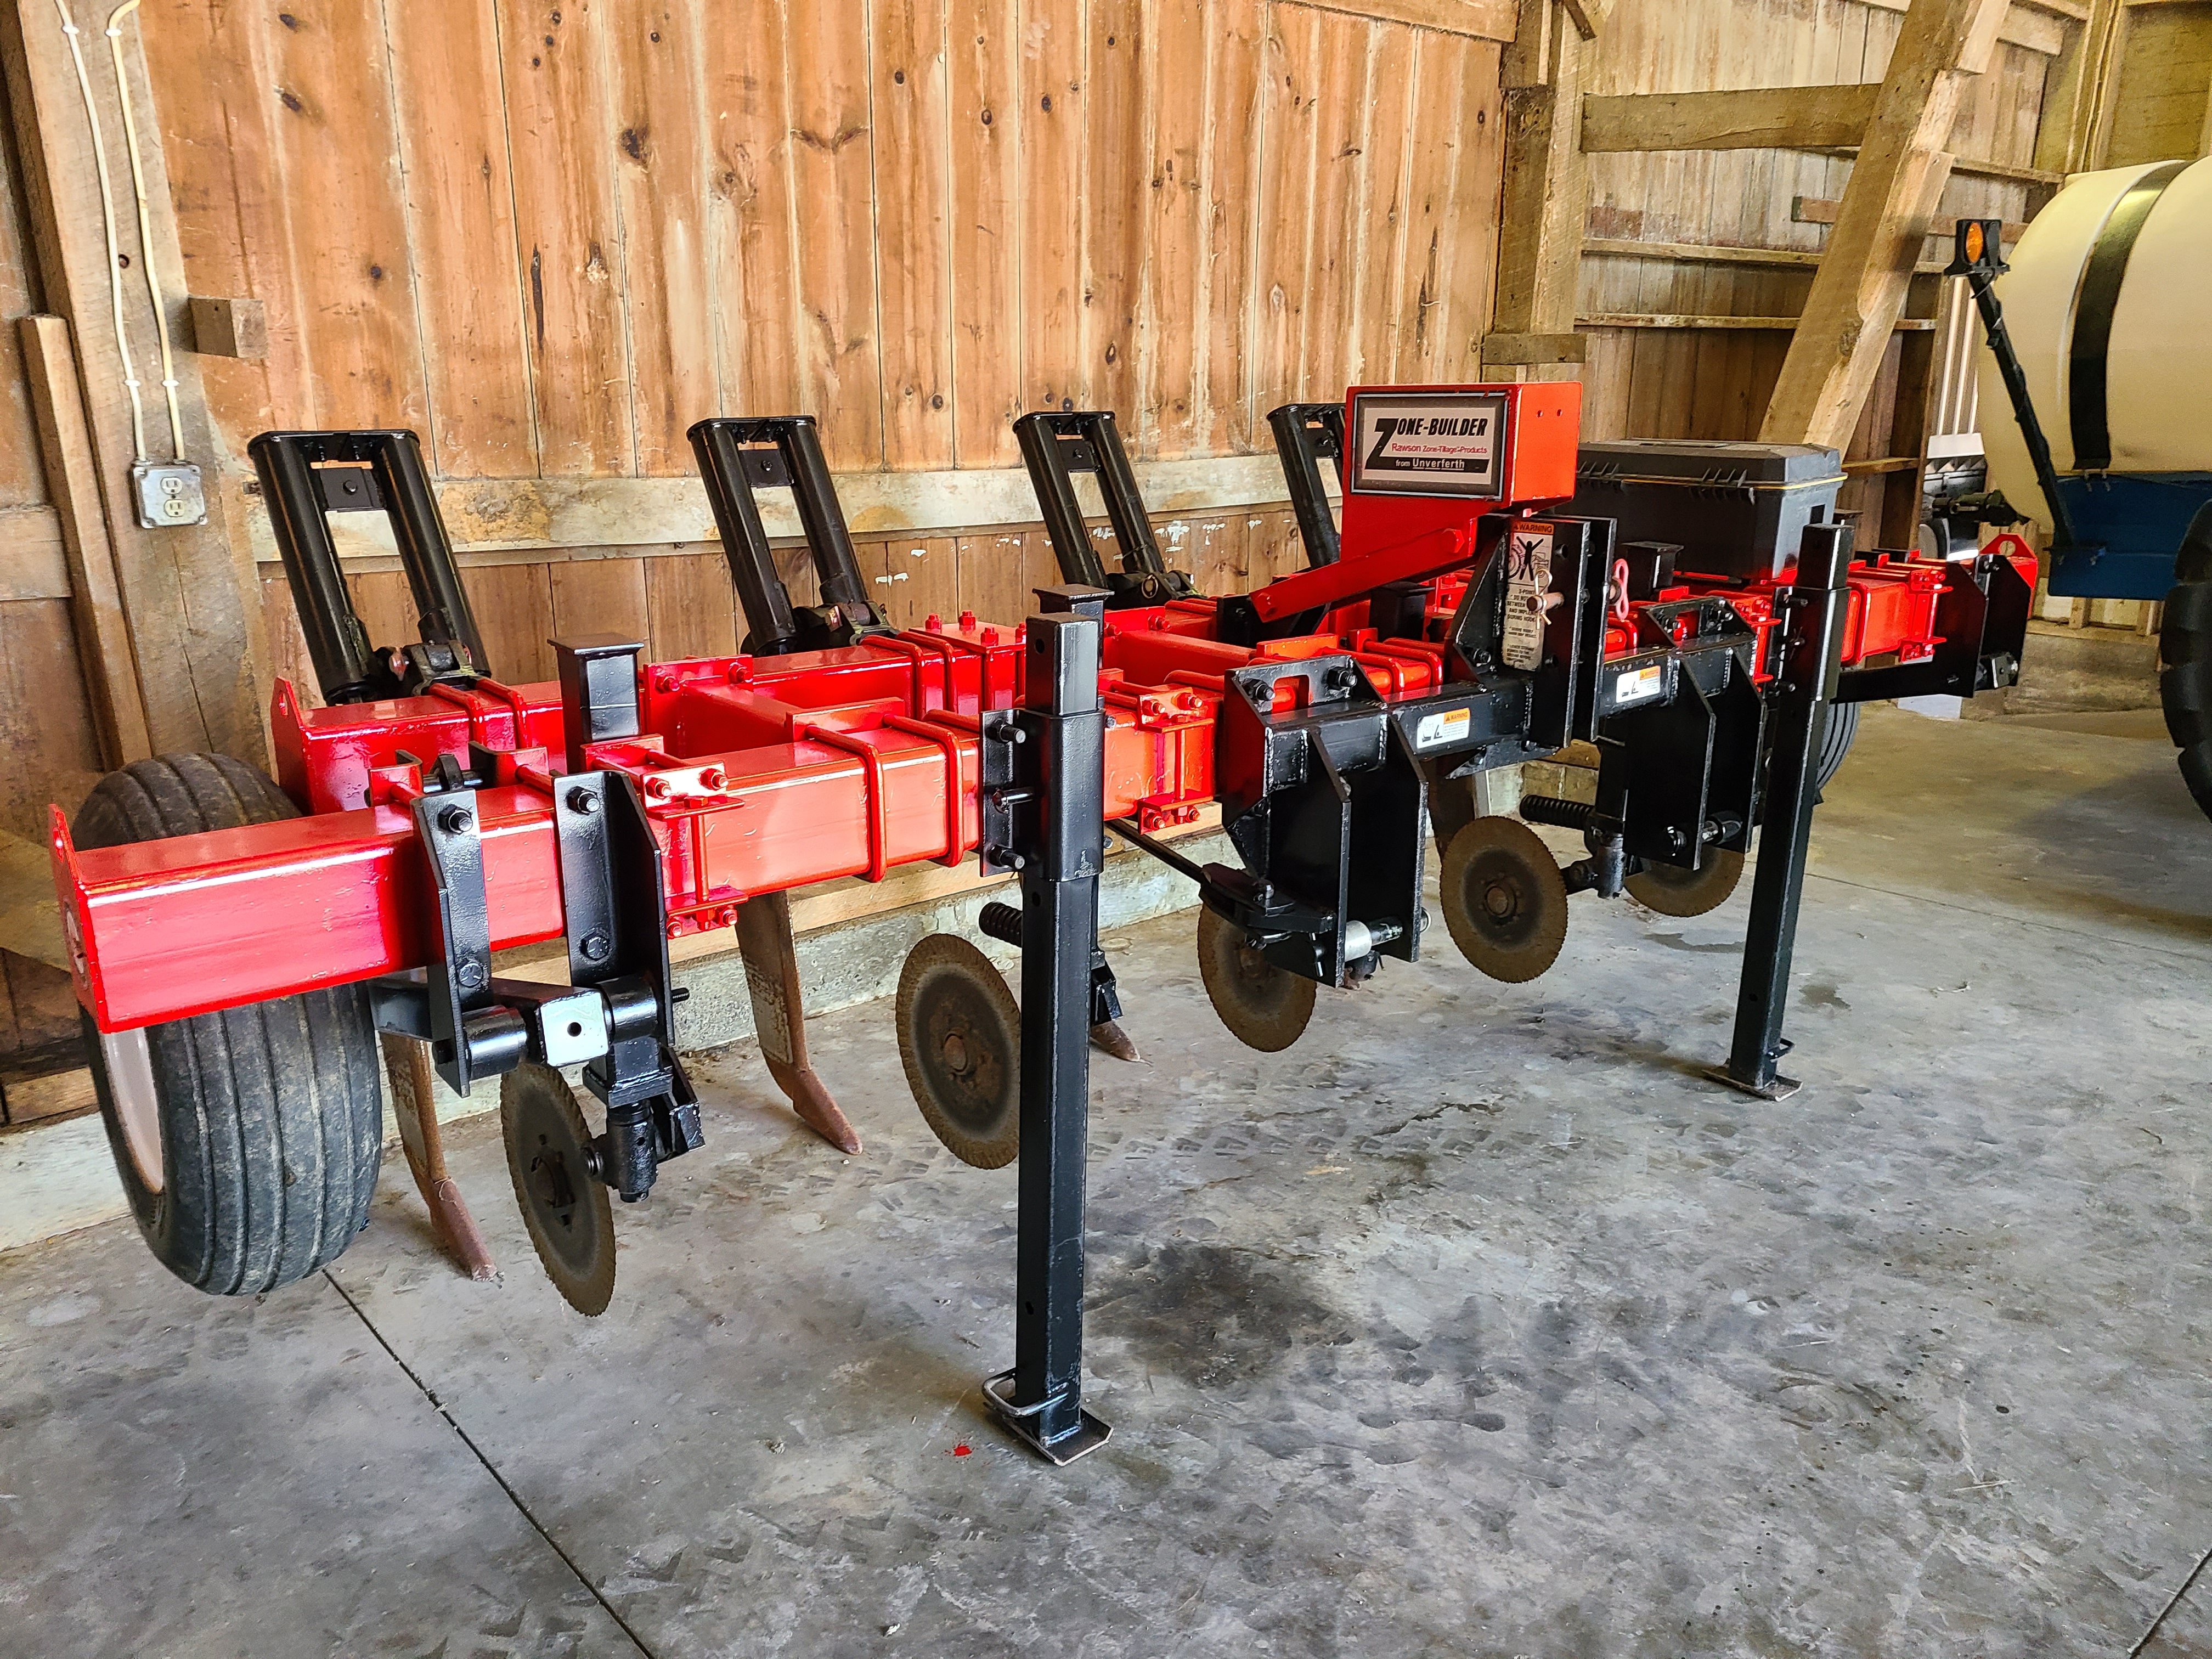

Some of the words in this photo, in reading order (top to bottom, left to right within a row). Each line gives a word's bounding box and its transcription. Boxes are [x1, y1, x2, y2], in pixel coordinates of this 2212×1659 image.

[1391, 443, 1421, 452] Rawson
[1412, 458, 1465, 469] Unverferth
[1519, 523, 1553, 533] WARNING
[1451, 712, 1468, 720] WARNING
